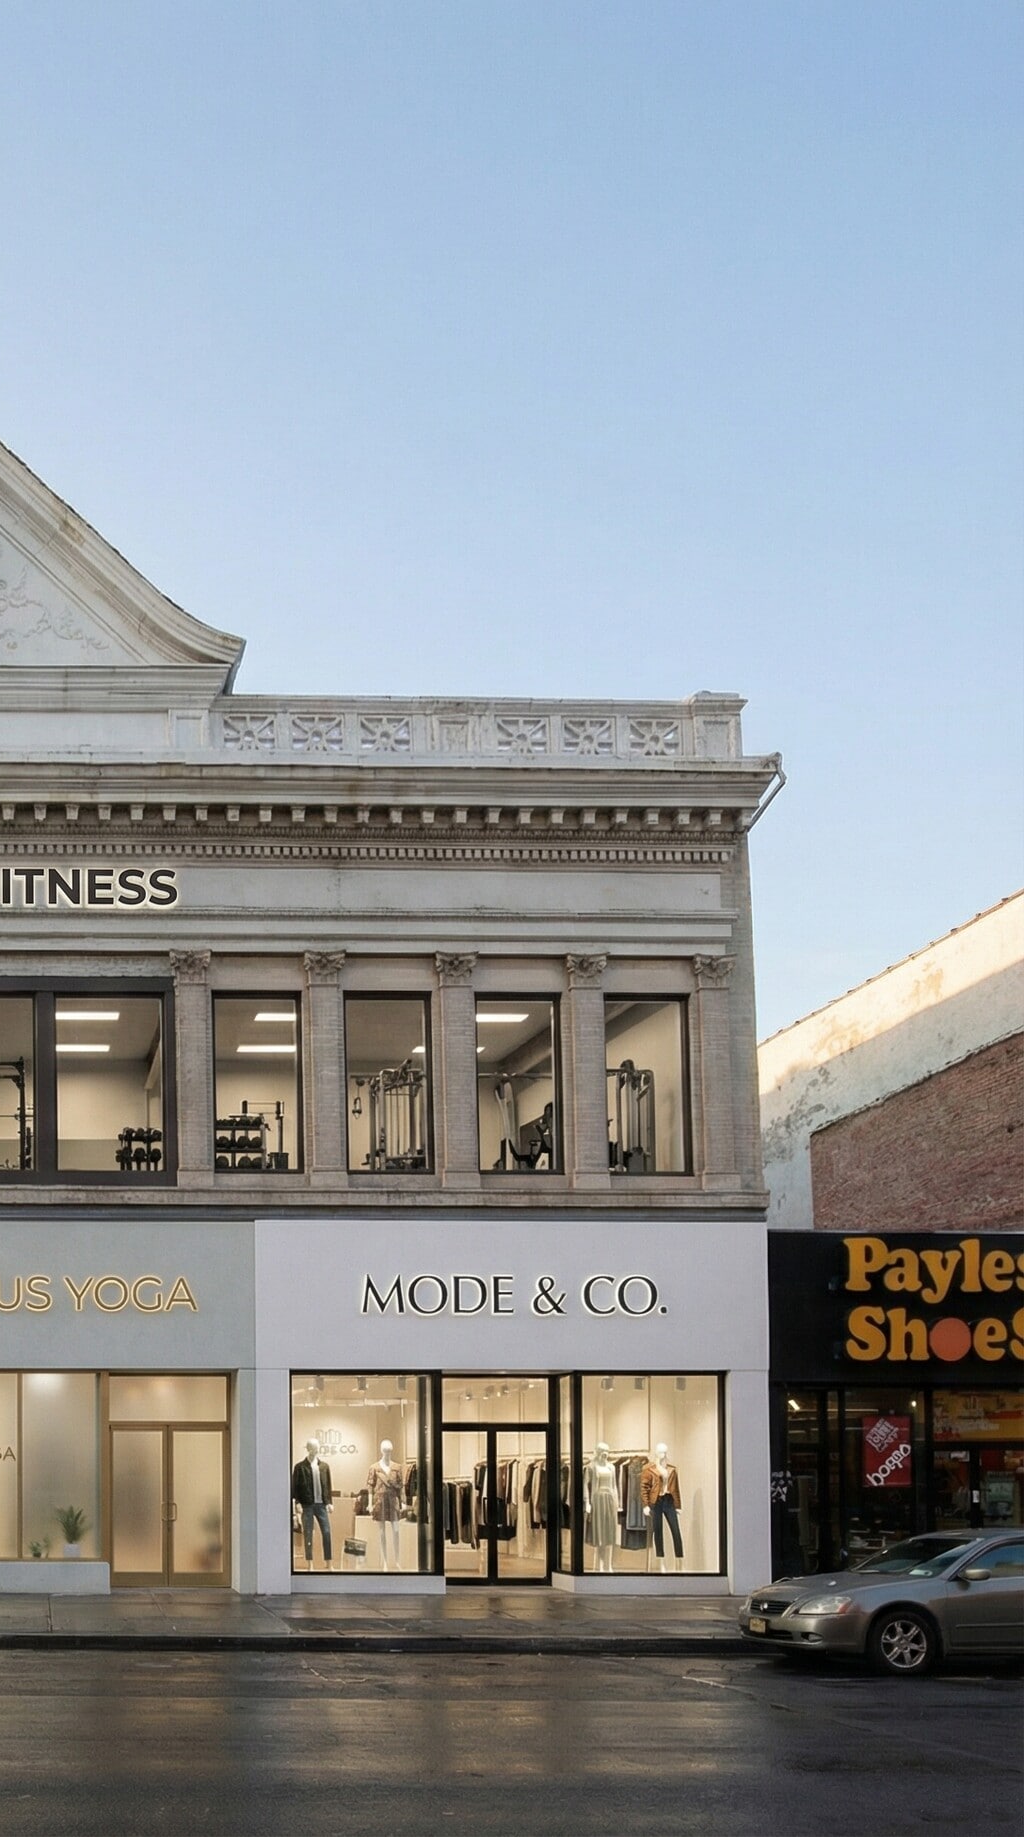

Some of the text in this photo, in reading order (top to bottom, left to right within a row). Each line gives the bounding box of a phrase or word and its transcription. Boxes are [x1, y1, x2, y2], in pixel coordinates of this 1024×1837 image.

[64, 1275, 198, 1312] YOGA
[362, 1273, 668, 1315] MODE & CO.
